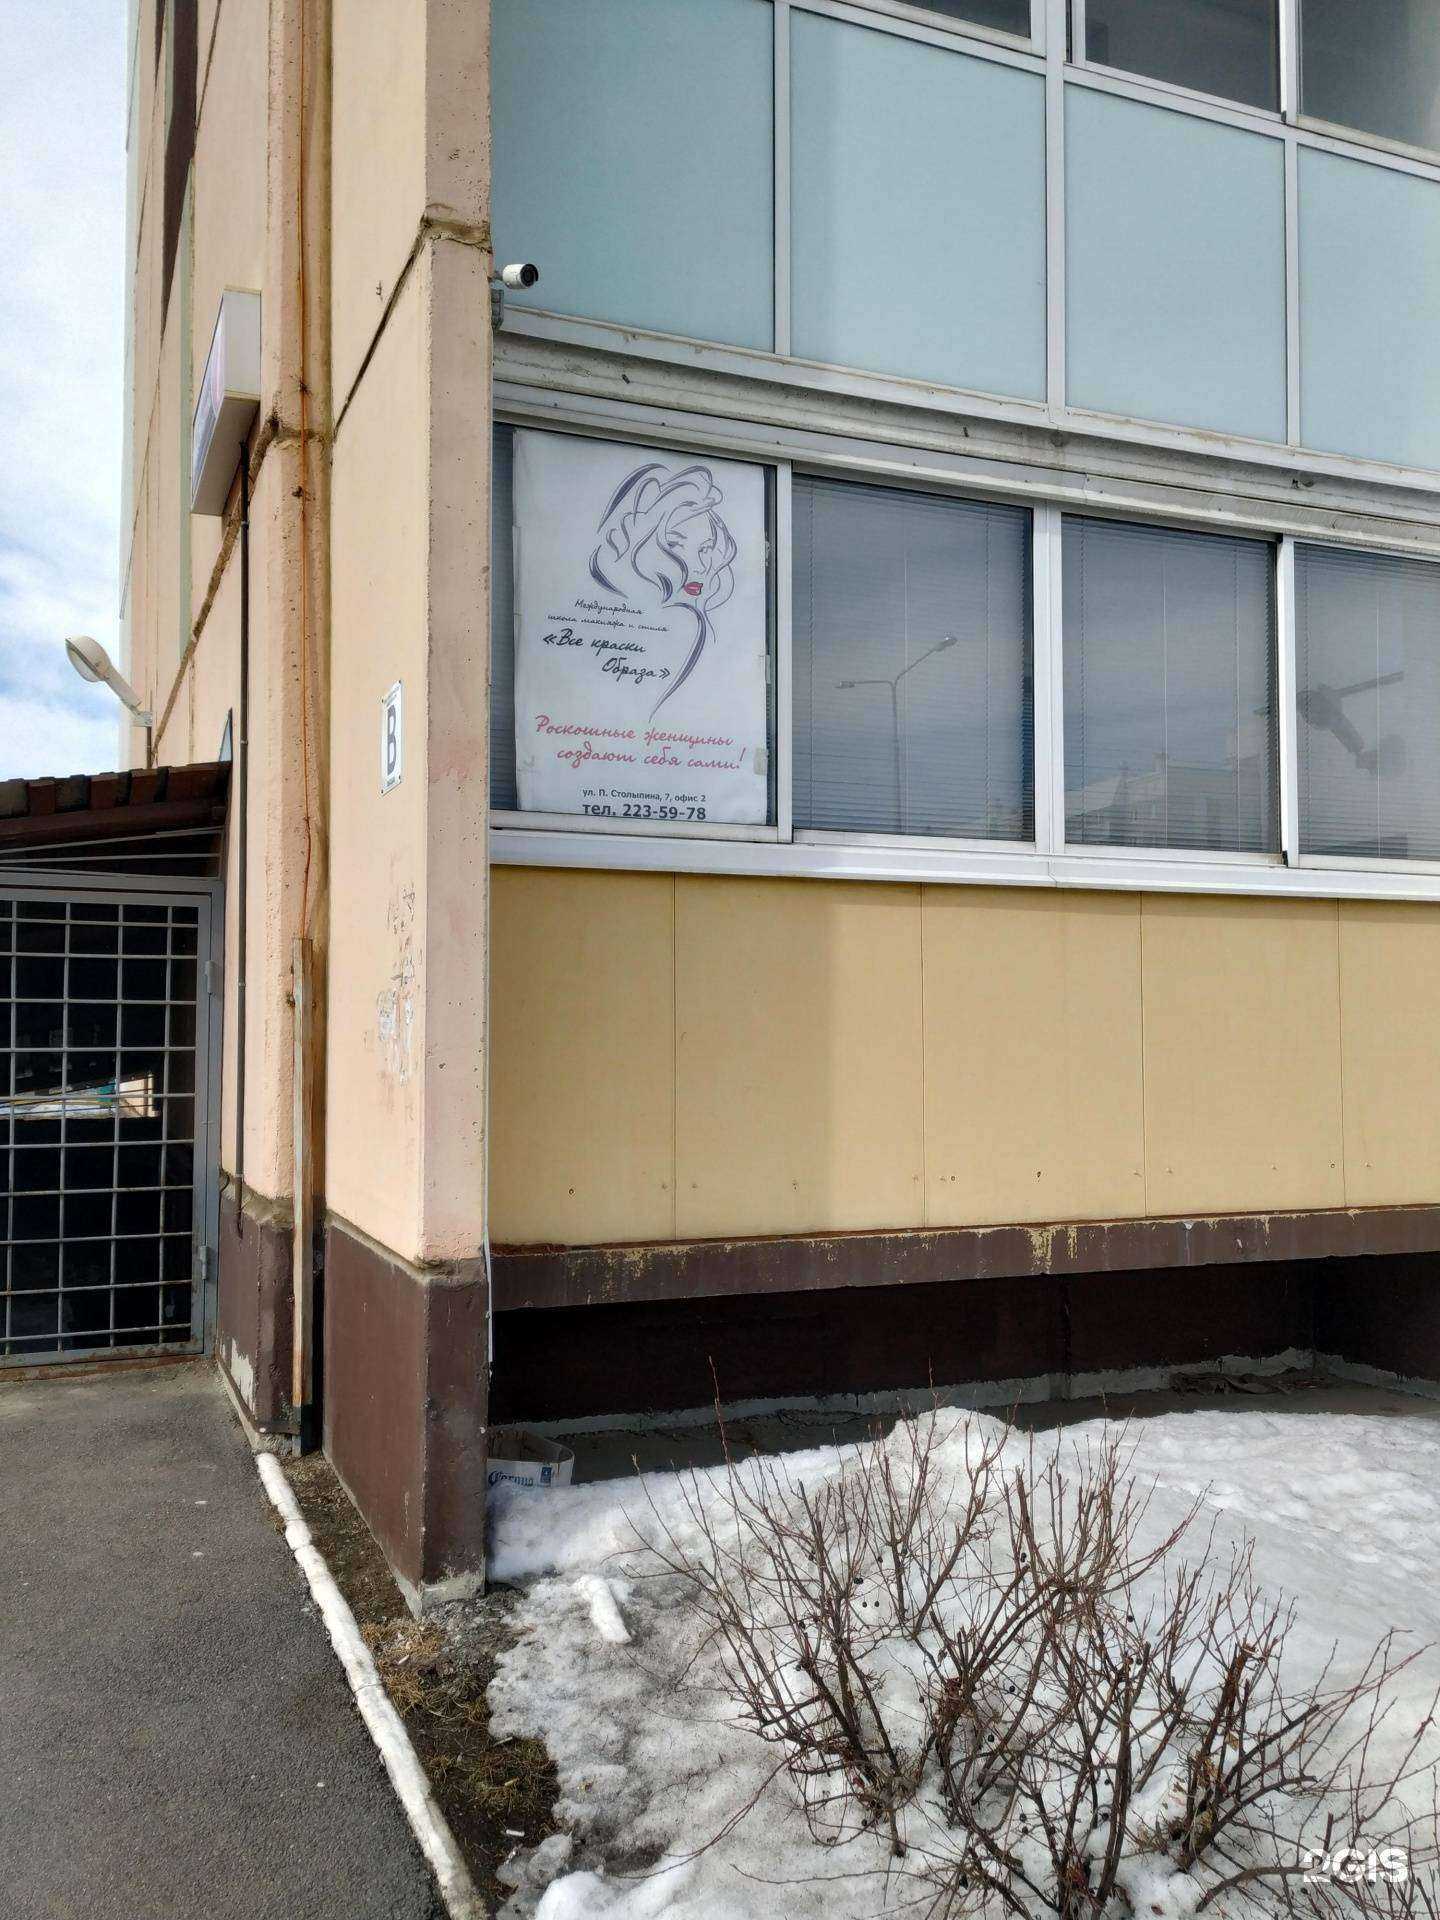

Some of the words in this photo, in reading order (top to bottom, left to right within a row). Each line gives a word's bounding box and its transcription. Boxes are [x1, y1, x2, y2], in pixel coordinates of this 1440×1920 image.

[574, 599, 643, 615] Международная
[548, 615, 577, 623] школа
[543, 629, 583, 646] «Все
[590, 638, 646, 656] краски
[602, 658, 670, 684] Образа»
[536, 715, 635, 740] Роскошные
[644, 727, 733, 748] женщины
[557, 741, 636, 768] создают
[644, 747, 682, 765] себя
[687, 748, 746, 769] сами!
[583, 790, 595, 798] ул.
[598, 789, 608, 797] П.
[611, 789, 662, 802] Столыпина,
[665, 794, 672, 802] 7,
[675, 794, 698, 803] офис
[583, 804, 617, 816] тел.
[623, 804, 706, 819] 223-59-78
